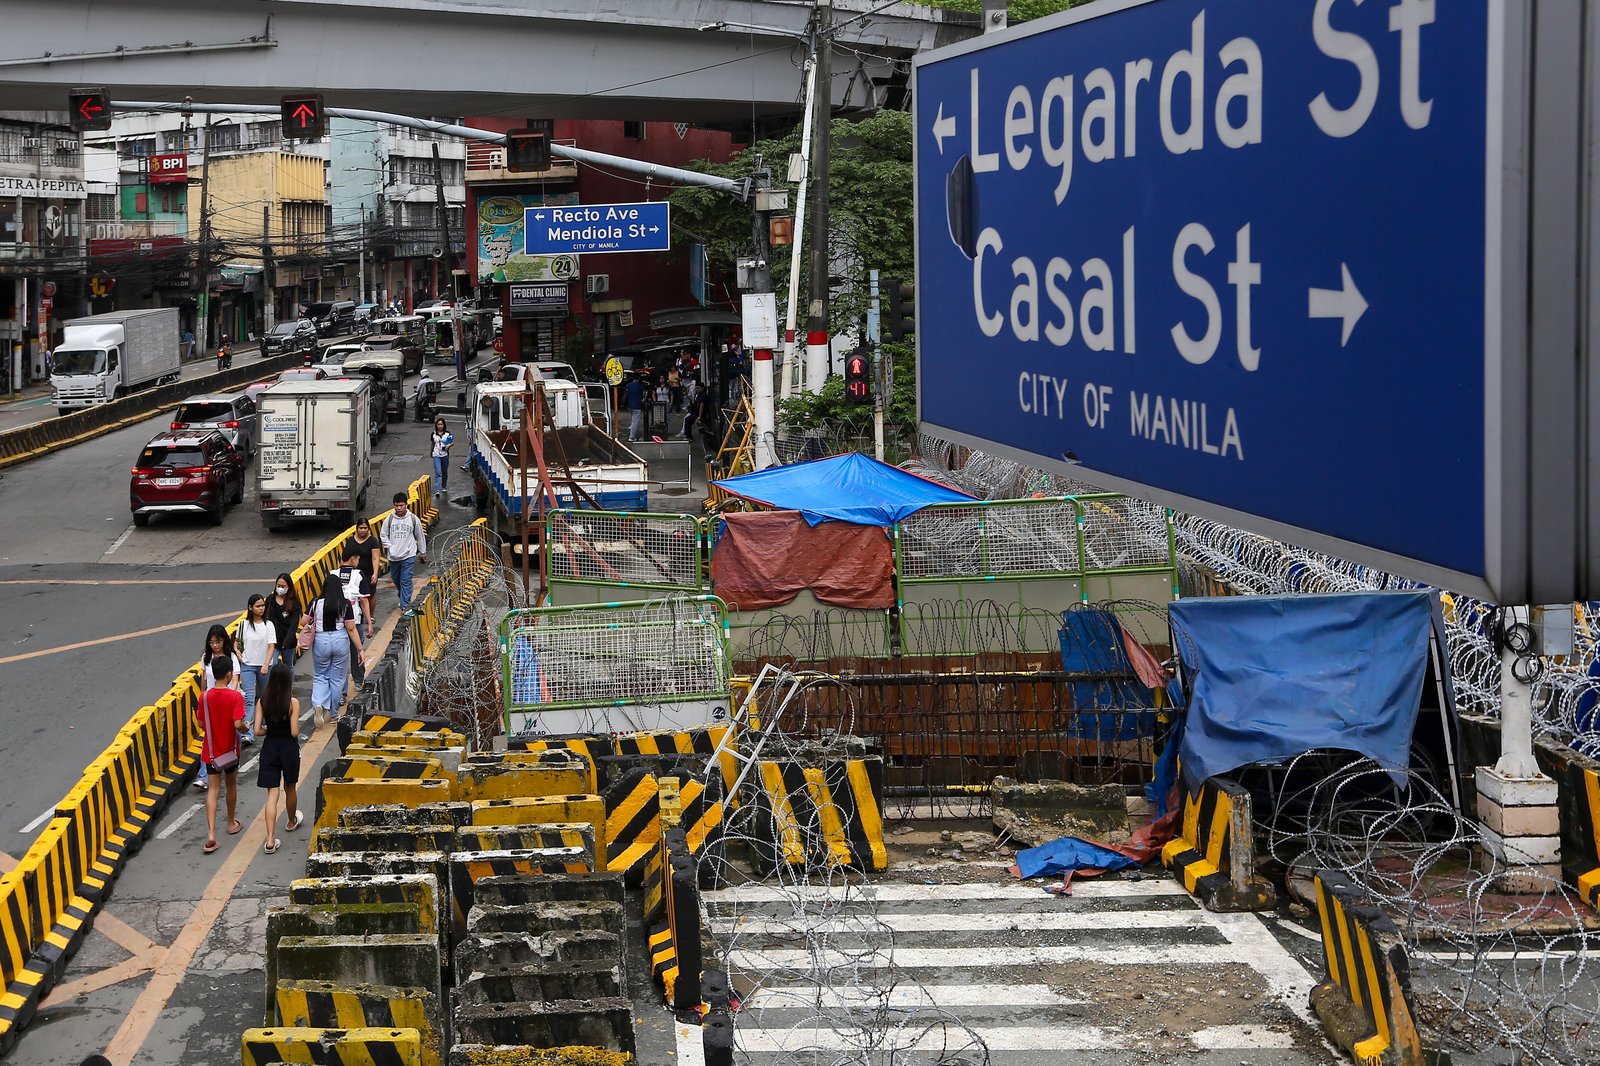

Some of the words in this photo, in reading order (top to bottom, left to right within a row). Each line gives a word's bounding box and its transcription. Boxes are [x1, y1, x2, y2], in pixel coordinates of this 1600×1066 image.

[970, 8, 1263, 206] Legarda
[1308, 0, 1436, 138] St
[163, 158, 183, 169] BPI
[42, 181, 85, 191] PEPITA
[552, 208, 600, 222] Recto
[606, 207, 638, 220] Ave
[548, 226, 622, 241] Mendiola
[628, 224, 646, 238] St
[555, 261, 571, 273] 24
[521, 288, 545, 298] DENTAL
[545, 287, 566, 297] CLINIC
[973, 225, 1136, 355] Casal
[1170, 222, 1262, 372] St
[850, 382, 865, 395] 41
[1019, 371, 1068, 419] CITY
[1083, 382, 1113, 429] OF
[1130, 390, 1244, 461] MANILA
